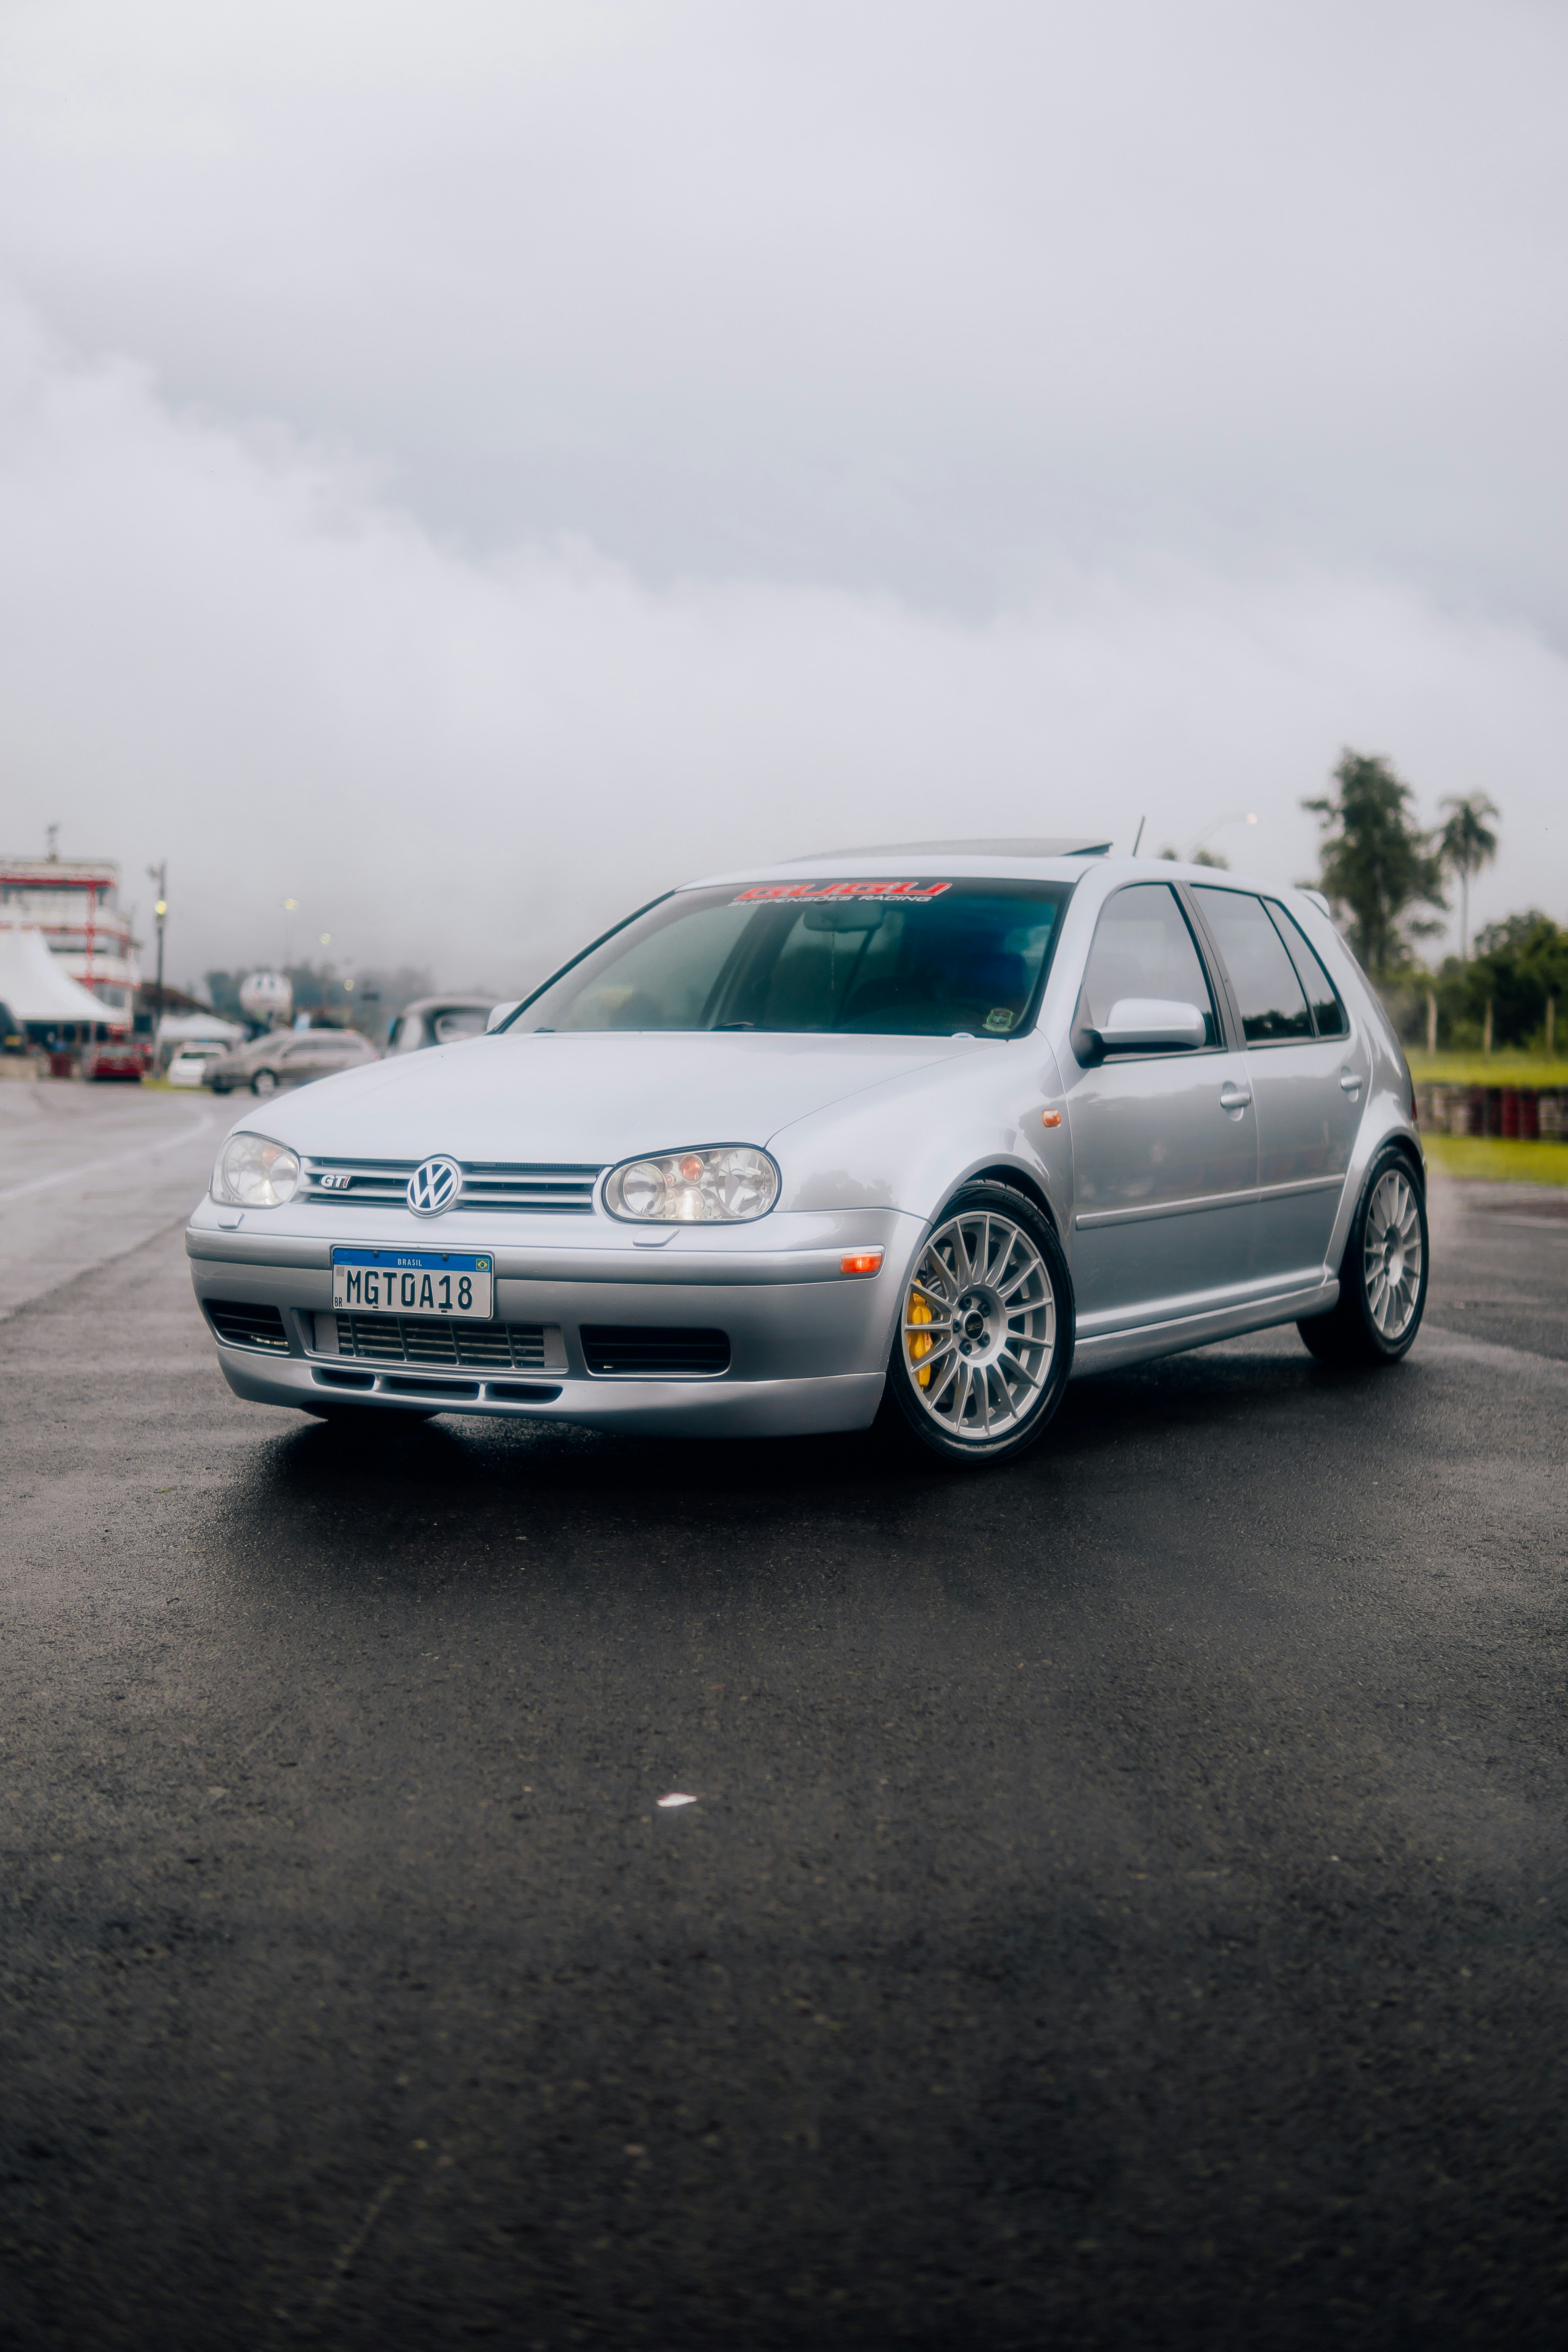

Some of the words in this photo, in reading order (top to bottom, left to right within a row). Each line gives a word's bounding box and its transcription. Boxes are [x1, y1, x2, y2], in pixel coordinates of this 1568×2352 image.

[734, 882, 952, 901] GUGU
[321, 1175, 351, 1188] GTI
[397, 1258, 422, 1267] BRASIL
[334, 1297, 343, 1307] BR
